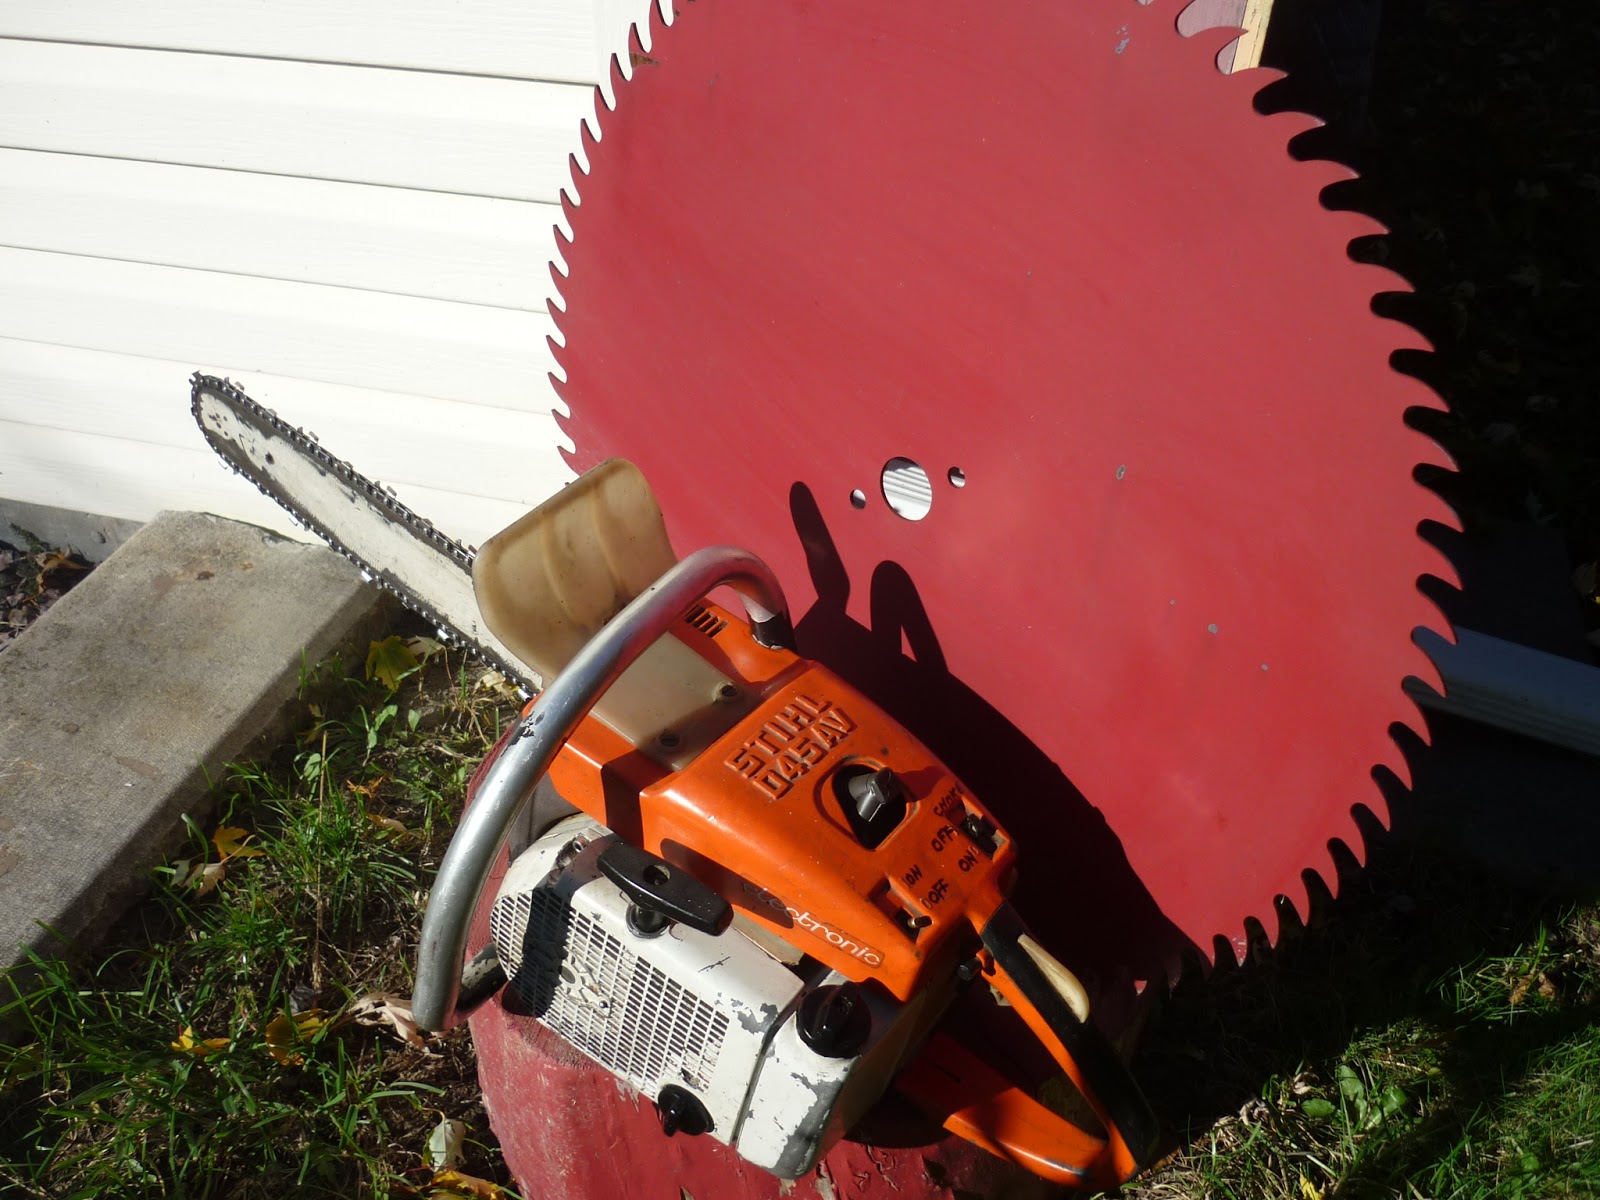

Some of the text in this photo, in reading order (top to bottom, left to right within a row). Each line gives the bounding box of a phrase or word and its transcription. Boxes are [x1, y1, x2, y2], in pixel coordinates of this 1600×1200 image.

[724, 695, 832, 779] STIHL
[931, 825, 955, 852] OFF
[958, 850, 979, 872] ON
[928, 878, 949, 904] OFF
